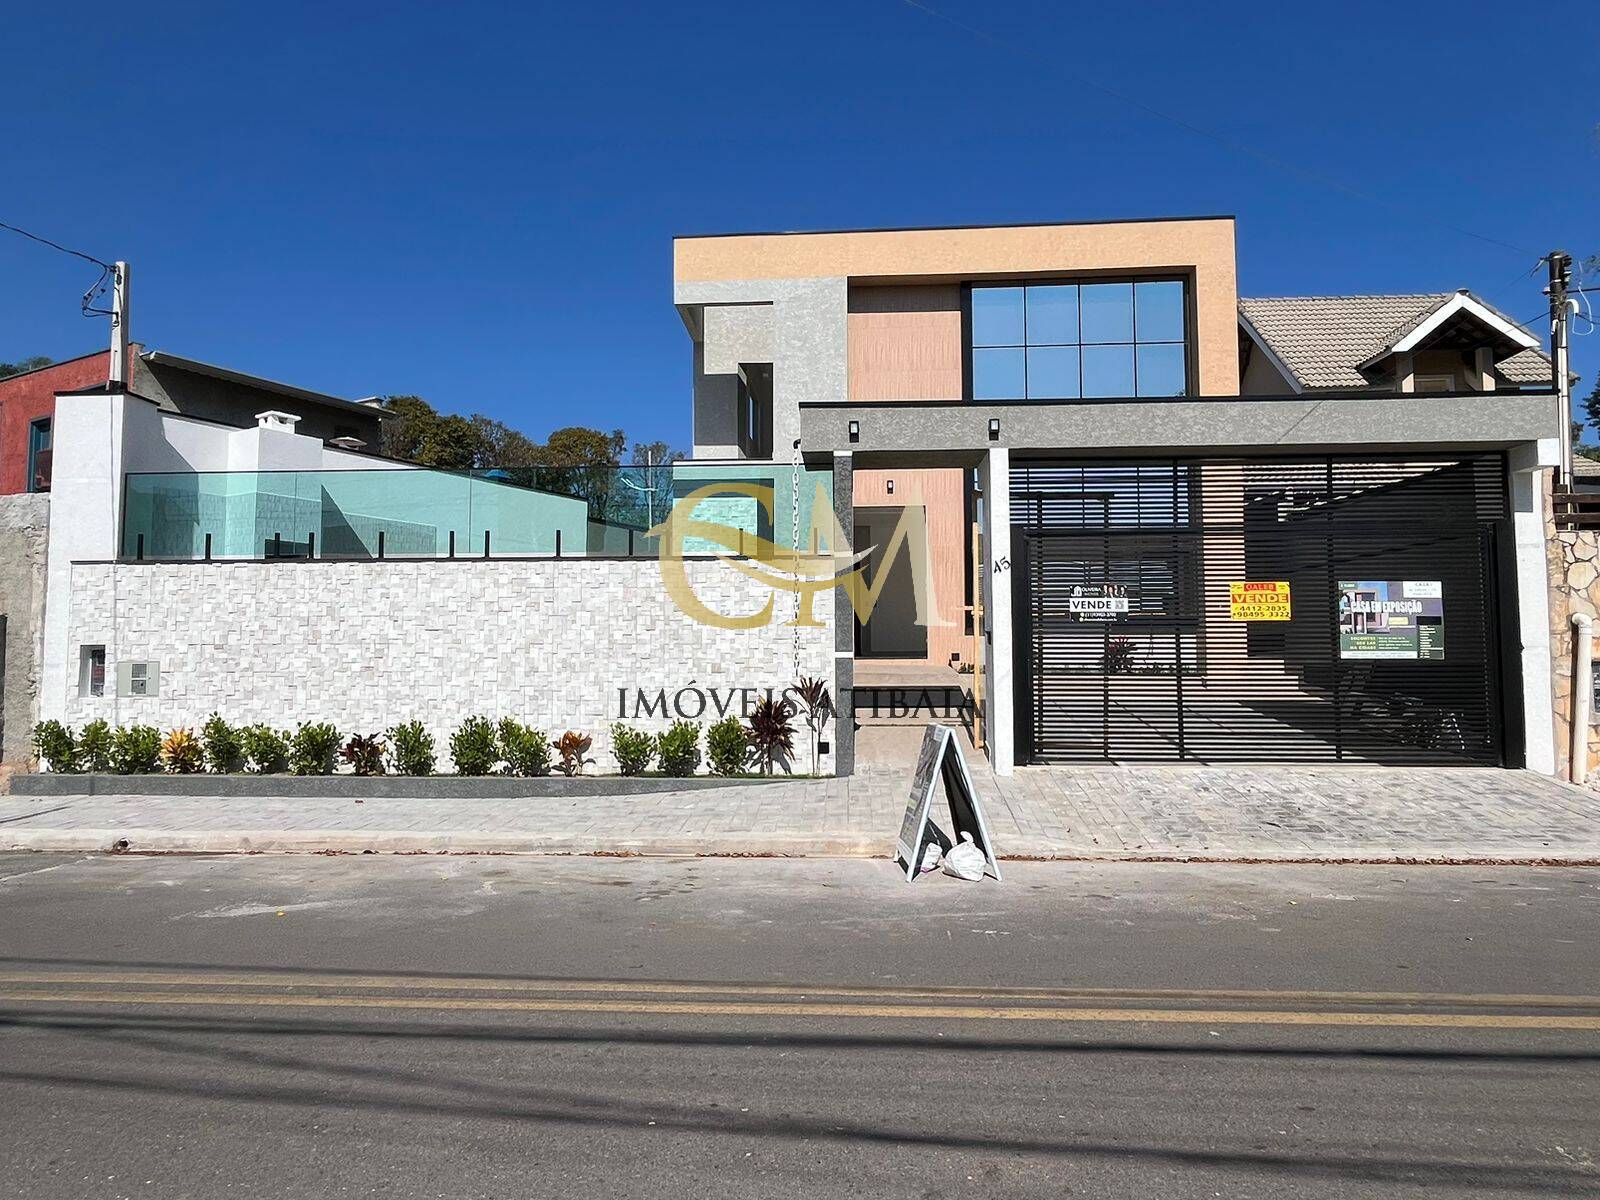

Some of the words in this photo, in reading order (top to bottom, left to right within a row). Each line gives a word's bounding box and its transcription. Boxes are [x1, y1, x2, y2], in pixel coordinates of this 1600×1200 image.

[1233, 594, 1288, 603] VENDE
[1072, 600, 1112, 610] VENDE
[1351, 601, 1370, 613] CASA
[1371, 601, 1382, 613] EM
[1383, 599, 1423, 615] EXPOSIÇÃO
